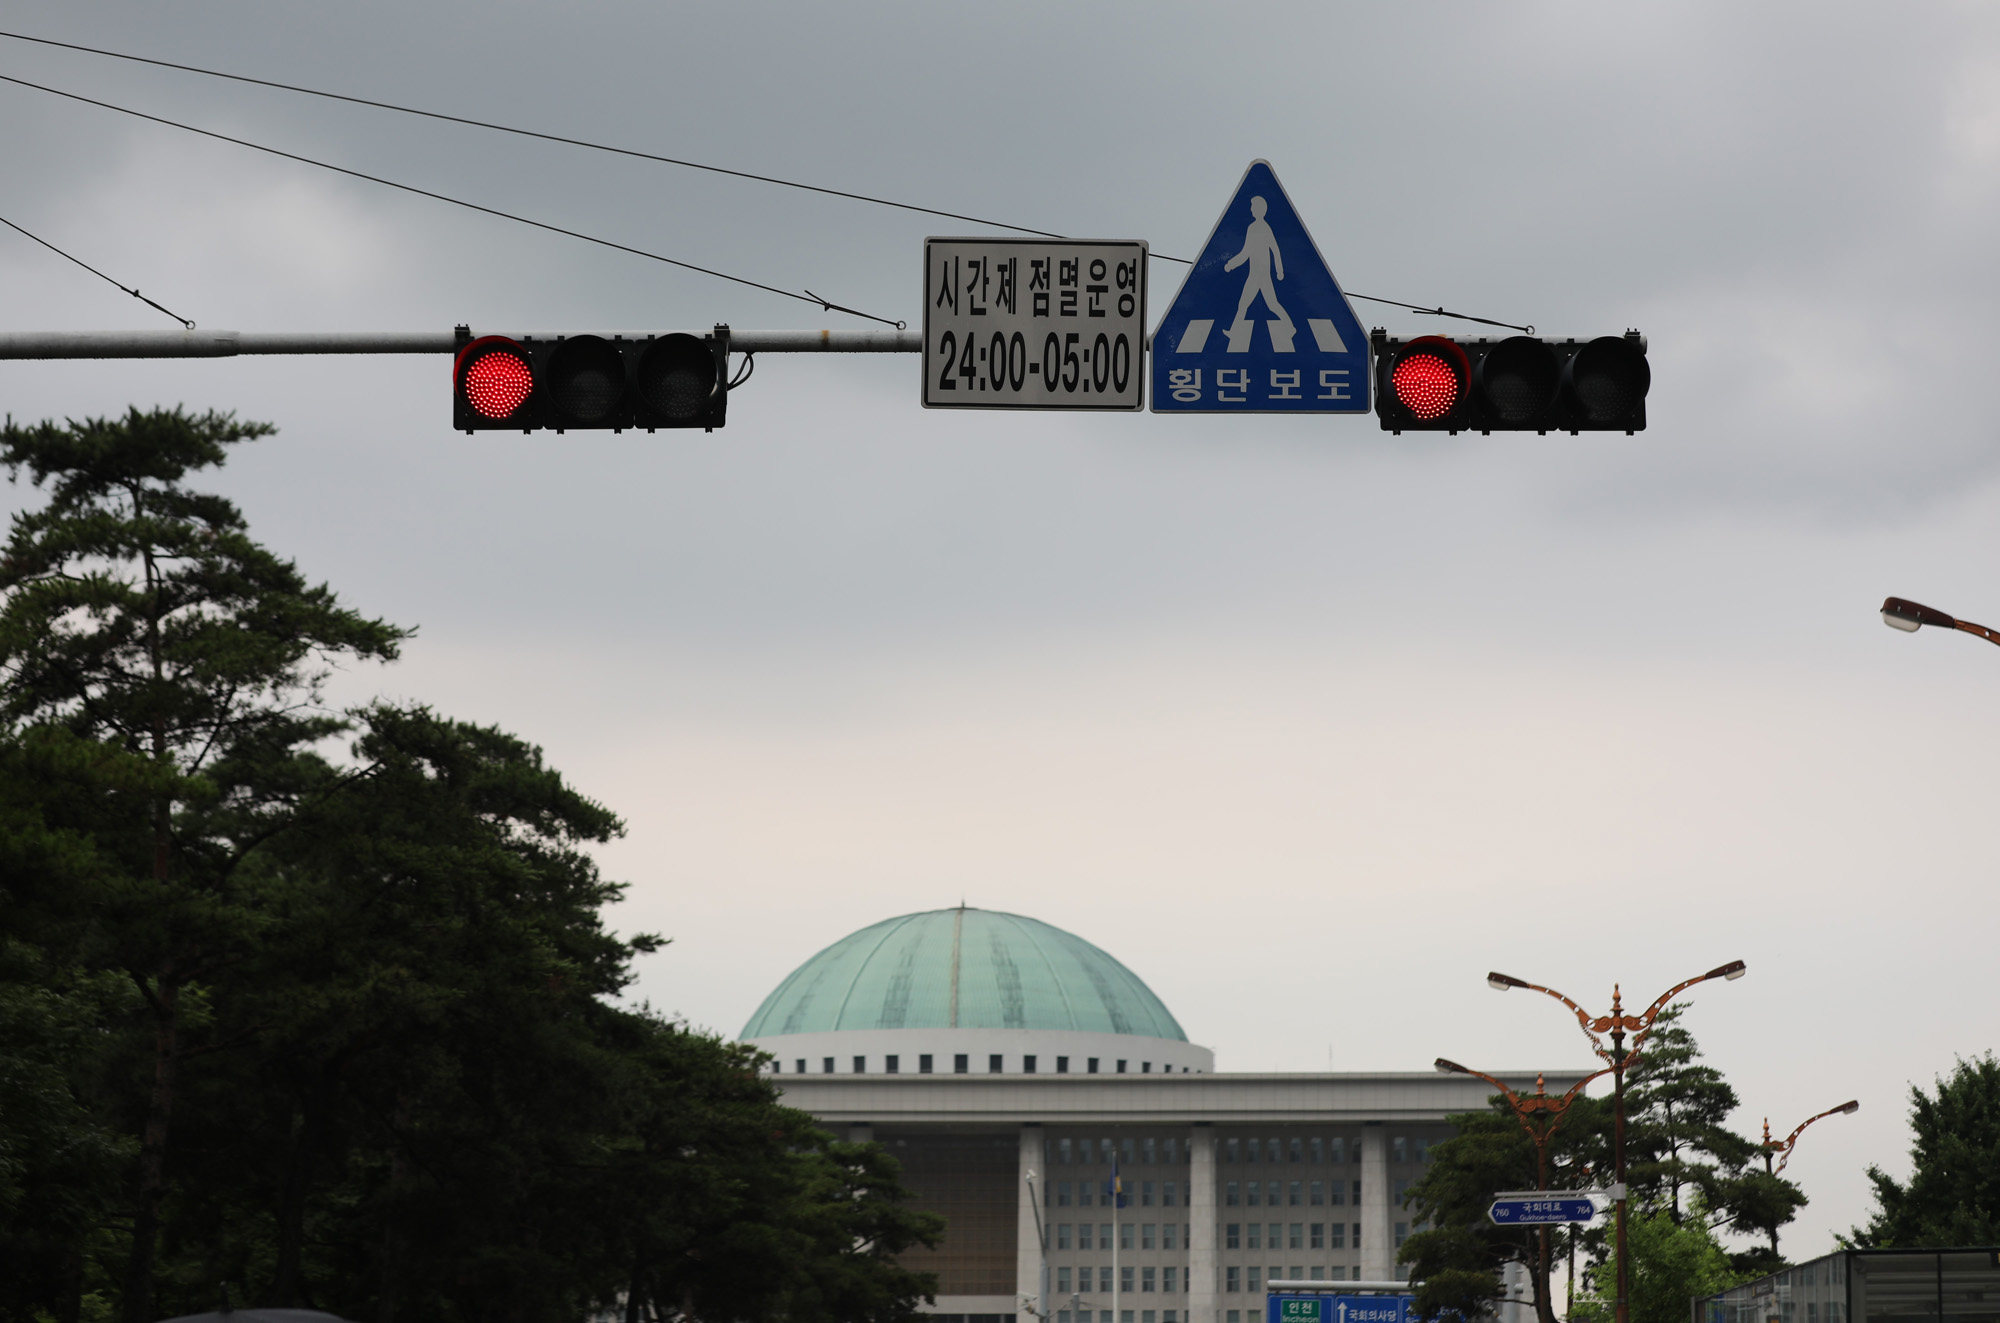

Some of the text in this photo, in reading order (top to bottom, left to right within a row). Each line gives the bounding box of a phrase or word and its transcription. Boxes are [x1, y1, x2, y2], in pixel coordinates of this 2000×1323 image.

[936, 255, 1137, 318] 시간제 점멸운영
[939, 330, 1130, 393] 24:00-05:00
[1168, 368, 1351, 402] 횡단보도
[1522, 1202, 1562, 1213] 국회대로
[1288, 1302, 1312, 1314] 인천
[1282, 1314, 1319, 1323] Incheon
[1349, 1309, 1397, 1323] 국회의사당
